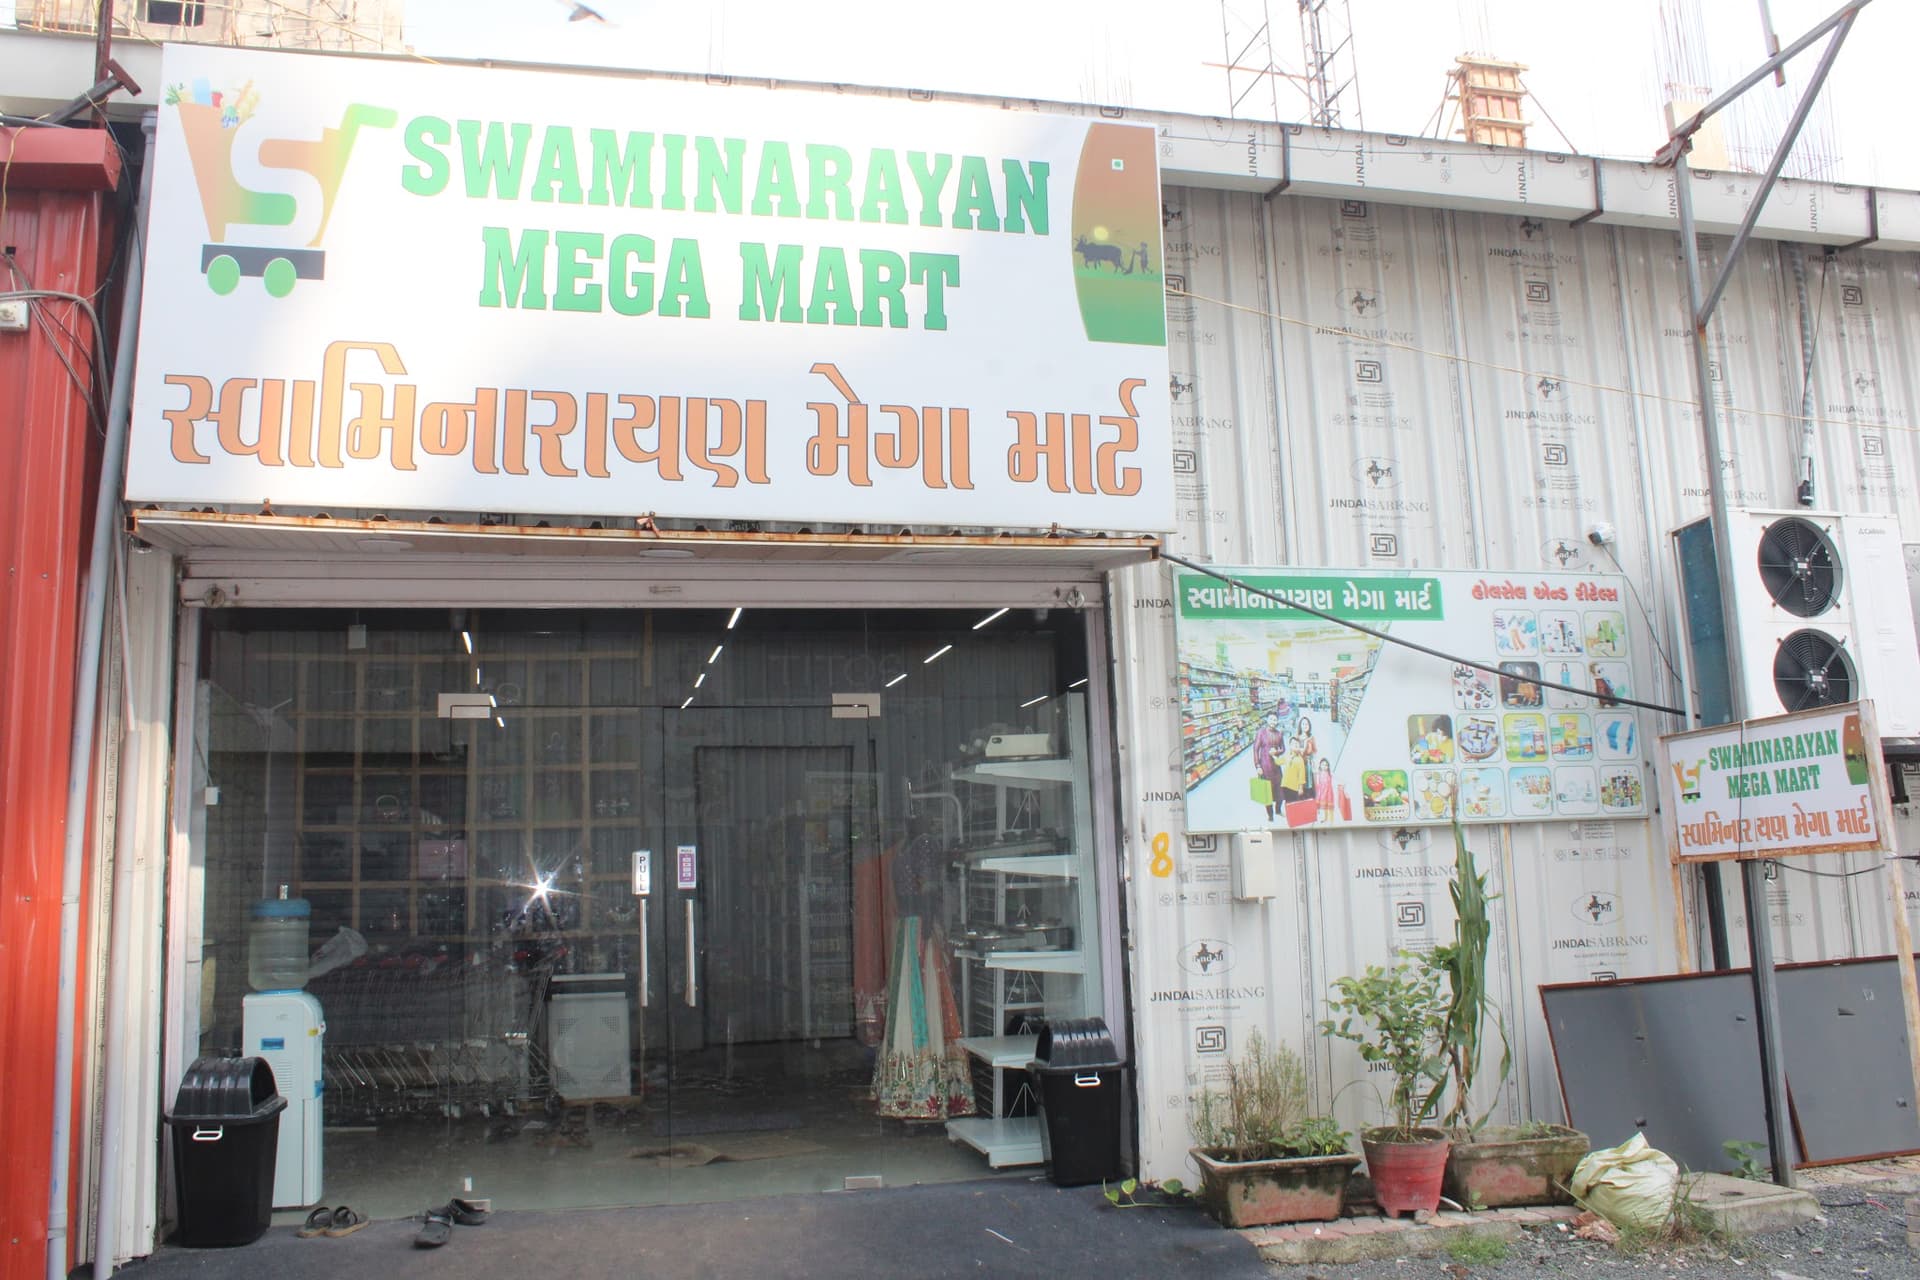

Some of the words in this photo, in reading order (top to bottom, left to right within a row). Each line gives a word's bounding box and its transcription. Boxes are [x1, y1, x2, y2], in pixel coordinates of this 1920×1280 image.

[400, 115, 1050, 236] SWAMINARAYAN
[479, 226, 711, 318] MEGA
[739, 242, 960, 332] MART
[162, 341, 771, 488] સ્વામિનારાયણ
[805, 362, 976, 490] મેગા
[1006, 377, 1147, 497] માર્ટ
[1682, 488, 1712, 497] JINDA
[1134, 598, 1172, 609] JINDA
[1188, 579, 1333, 610] સ્વામીનારાયણ
[1342, 581, 1385, 611] મેગા
[1395, 582, 1432, 611] માર્ટ
[1709, 729, 1839, 771] SWAMINARAYAN
[1726, 770, 1772, 799] MEGA
[1774, 764, 1821, 794] MART
[1792, 802, 1832, 839] મેગા
[1835, 794, 1871, 835] માર્ટ
[639, 856, 647, 891] PULL
[1151, 832, 1174, 878] 8
[1368, 1062, 1395, 1072] JIND
